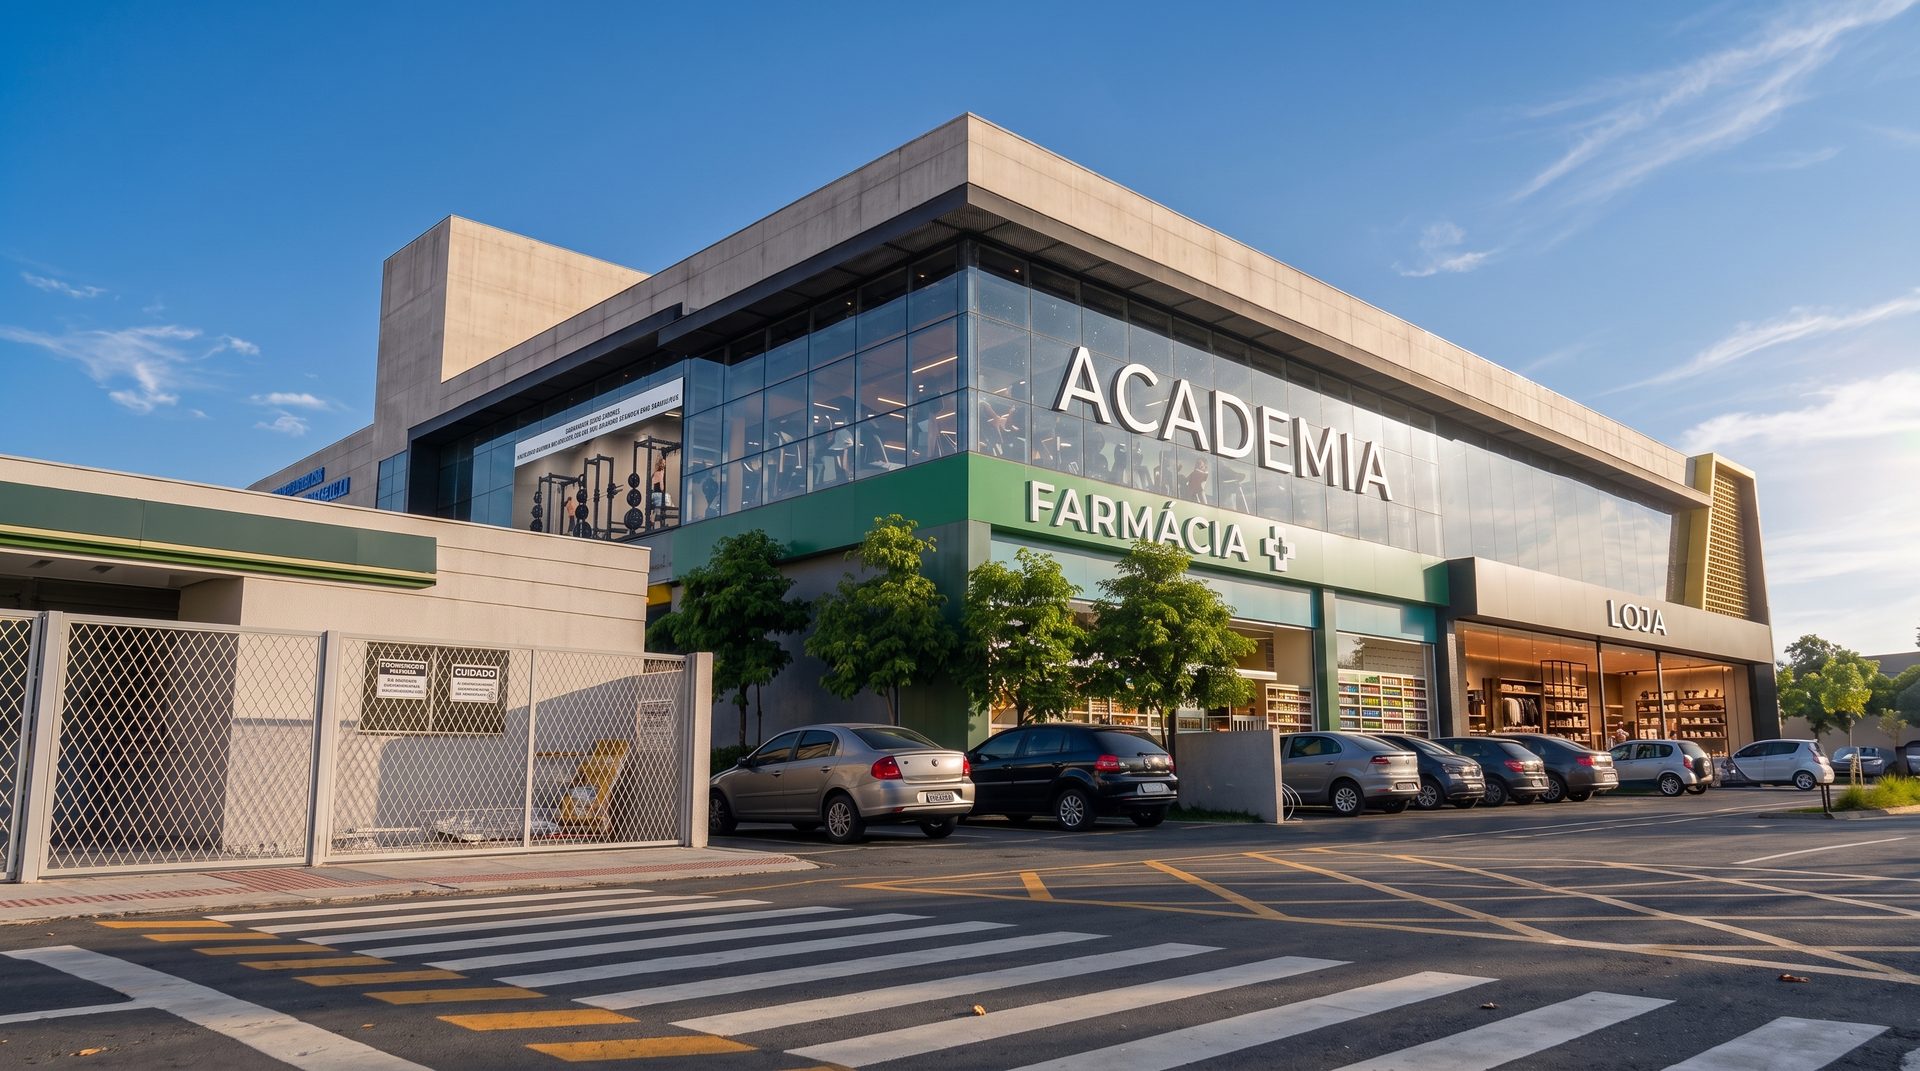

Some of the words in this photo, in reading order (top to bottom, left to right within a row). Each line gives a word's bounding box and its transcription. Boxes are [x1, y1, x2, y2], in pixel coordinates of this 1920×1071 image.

[1050, 346, 1393, 501] ACADEMIA
[1025, 479, 1249, 562] FARMÁCIA
[1606, 600, 1668, 636] LOJA
[455, 668, 495, 678] CUIDADO
